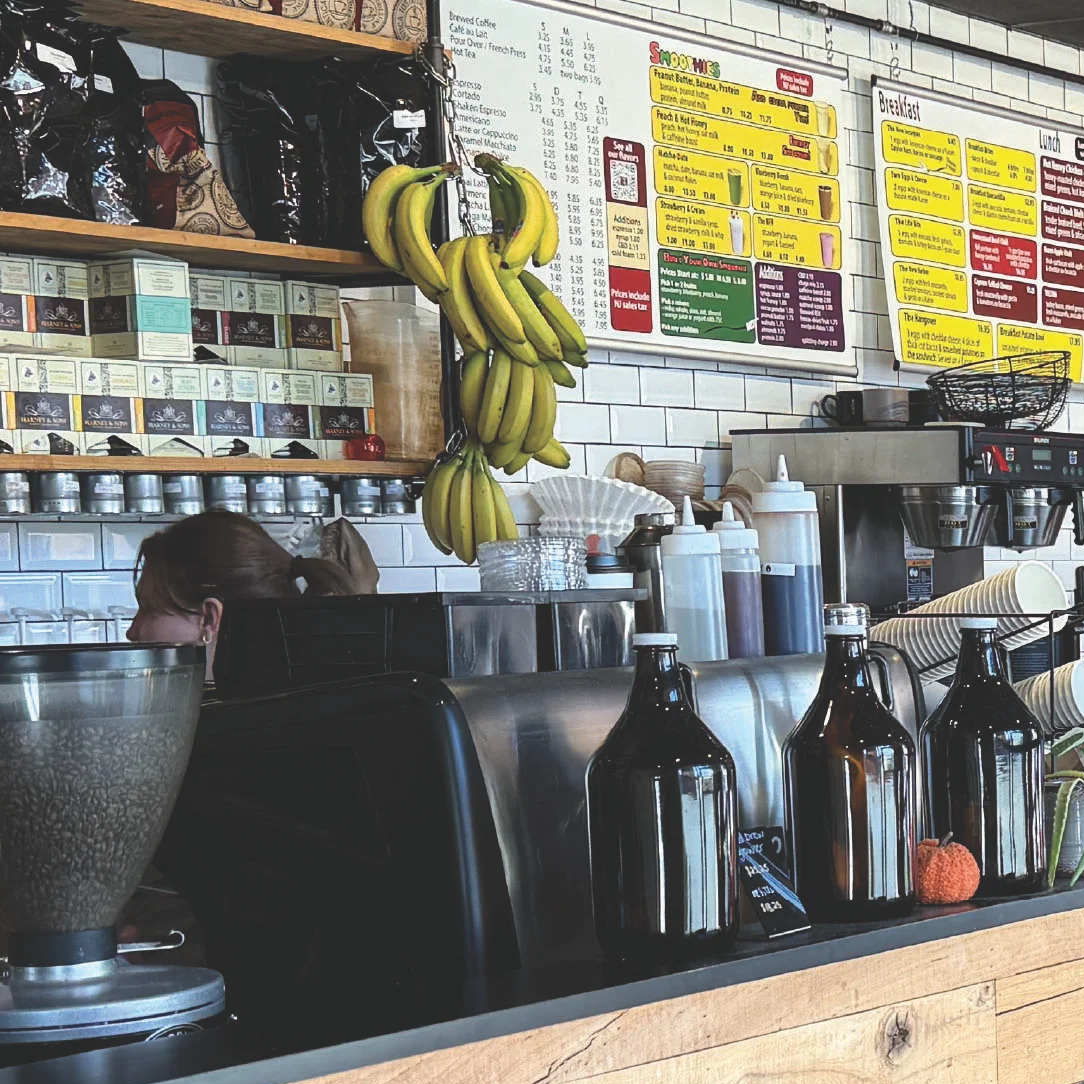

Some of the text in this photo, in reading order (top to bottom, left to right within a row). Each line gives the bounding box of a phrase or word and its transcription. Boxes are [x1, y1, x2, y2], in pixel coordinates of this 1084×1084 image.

[449, 10, 474, 25] Brewed
[475, 17, 497, 30] Coffee
[450, 34, 466, 46] Pour
[466, 38, 484, 49] Over
[488, 42, 510, 55] French
[464, 48, 476, 59] Tea
[453, 88, 480, 102] Cortado
[479, 104, 507, 118] Espresso
[878, 90, 921, 122] Breakfast
[481, 128, 519, 142] Cappuccino
[1039, 128, 1060, 154] Lunch
[484, 138, 518, 152] Macchiato
[611, 288, 650, 302] Prices include
[622, 300, 638, 310] sales
